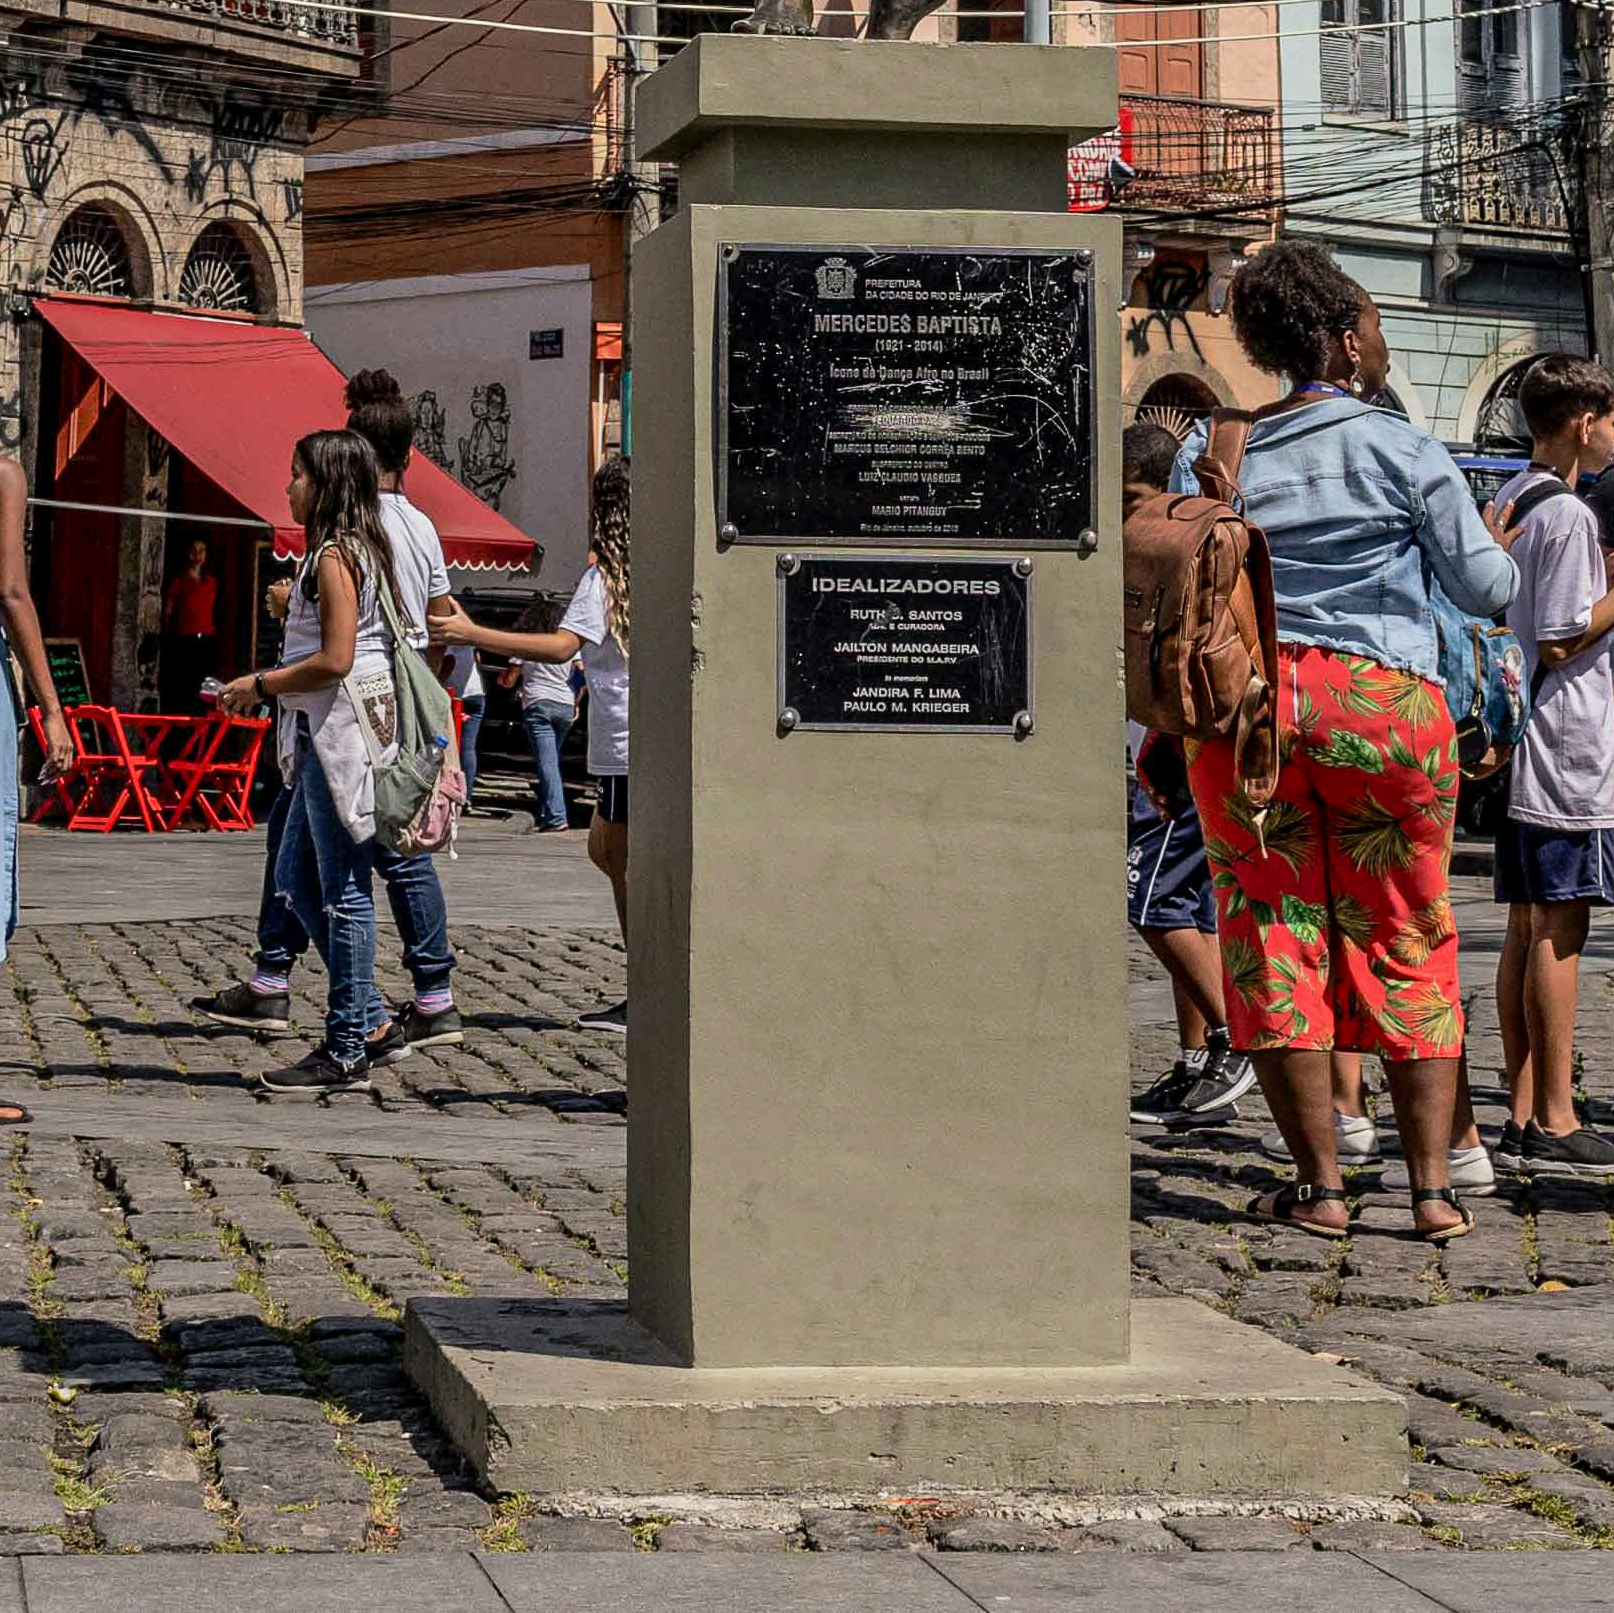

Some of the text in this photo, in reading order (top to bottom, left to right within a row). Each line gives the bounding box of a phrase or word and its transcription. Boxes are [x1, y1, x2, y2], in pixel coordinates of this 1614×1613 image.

[865, 279, 922, 288] PREFEITURA
[865, 290, 878, 300] DA
[879, 290, 914, 300] CIDADE
[915, 291, 929, 300] DO
[930, 291, 947, 301] RIO
[948, 292, 962, 301] DE
[814, 314, 1002, 335] MERCEDES BAPTISTA
[875, 339, 904, 353] (1921
[914, 339, 944, 354] 2014)
[862, 366, 875, 379] da
[878, 366, 913, 381] Dança
[915, 367, 938, 379] Afro
[940, 369, 954, 380] no
[957, 367, 989, 380] Brasil
[834, 443, 872, 454] MARCUS
[874, 443, 917, 455] BELCHIOR
[956, 445, 986, 455] BENTO
[858, 471, 879, 482] LUIZ
[881, 472, 919, 483] CLAUDIO
[871, 505, 947, 516] MARIO PITANGUY
[812, 577, 1001, 595] IDEALIZADORES
[850, 609, 886, 620] RUTH
[908, 610, 963, 621] SANTOS
[897, 623, 945, 631] CURADORA
[834, 642, 979, 654] JAILTON MANGABEIRA
[857, 655, 909, 663] PRESIDENTE
[852, 687, 961, 699] JANDIRA F. LIMA
[843, 701, 970, 713] PAULO M. KRIEGER
